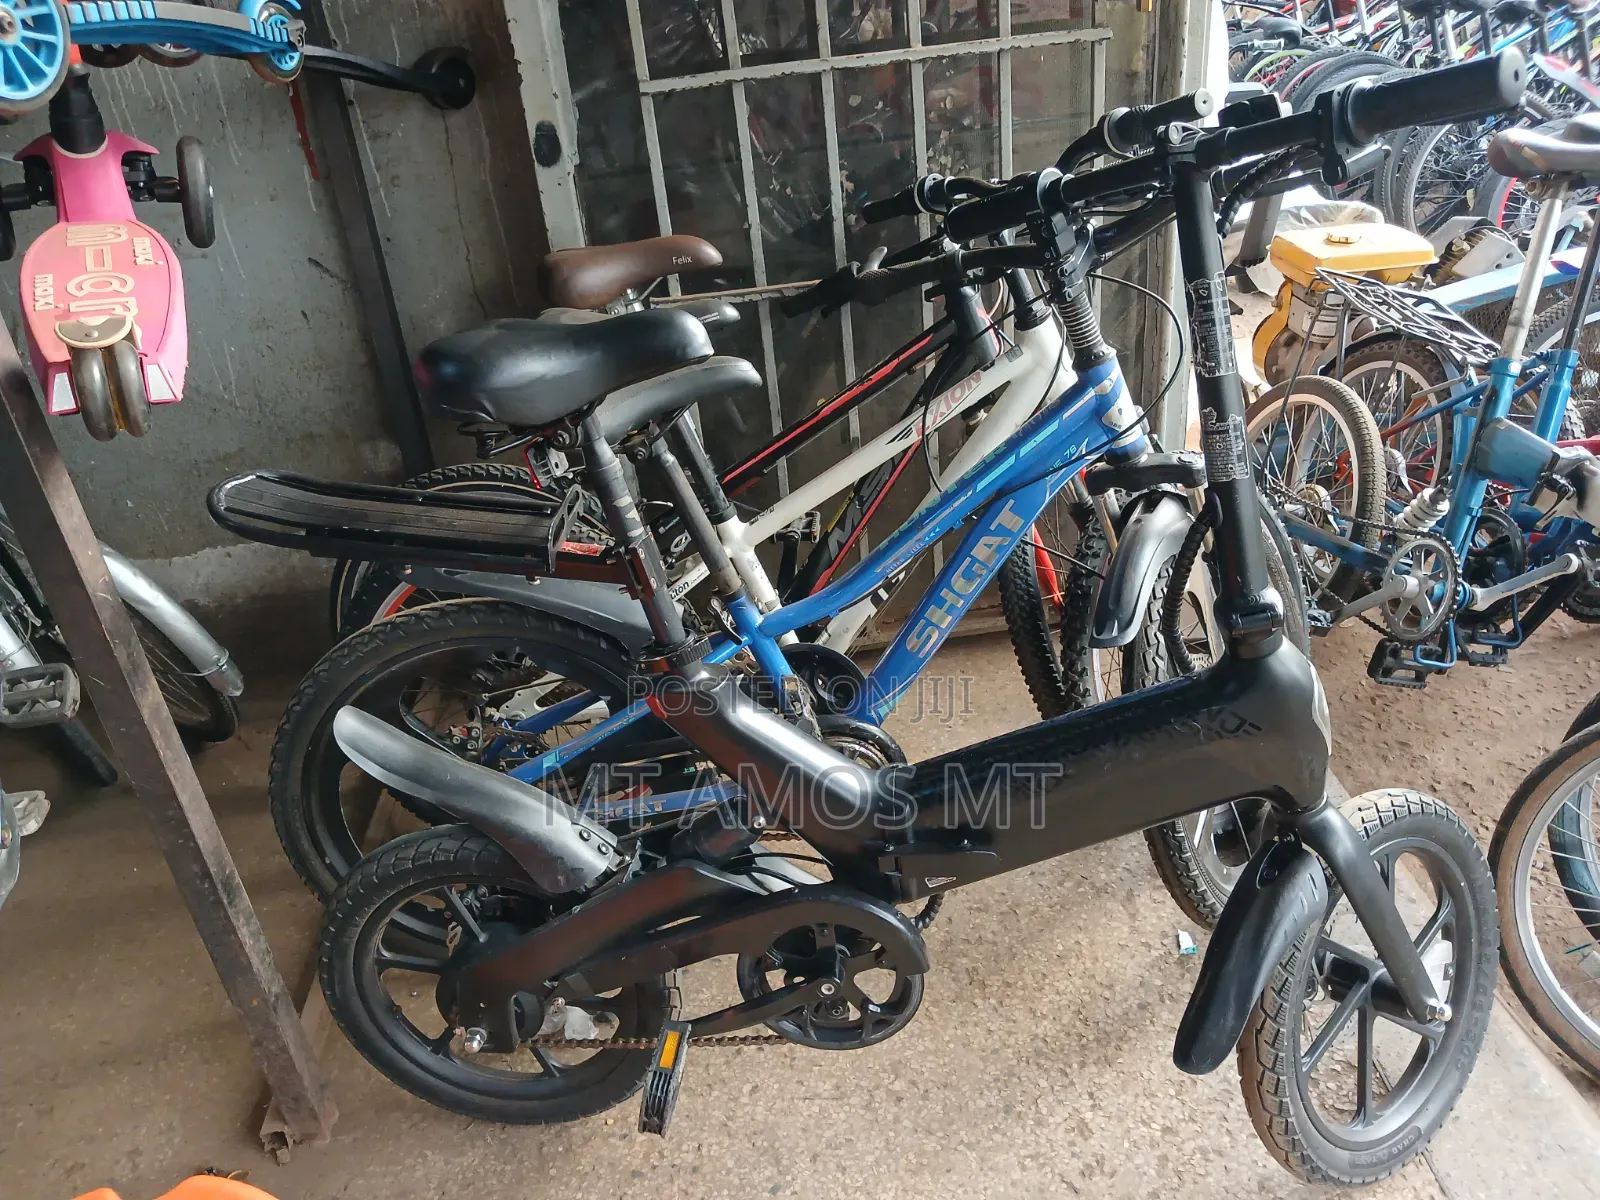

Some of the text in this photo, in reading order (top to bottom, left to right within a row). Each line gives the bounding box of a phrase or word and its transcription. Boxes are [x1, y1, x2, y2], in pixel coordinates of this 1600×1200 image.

[132, 237, 164, 265] maxi
[672, 255, 693, 265] Felix
[34, 273, 65, 312] maxi
[1063, 444, 1077, 459] 78
[905, 498, 1025, 659] SHGAT
